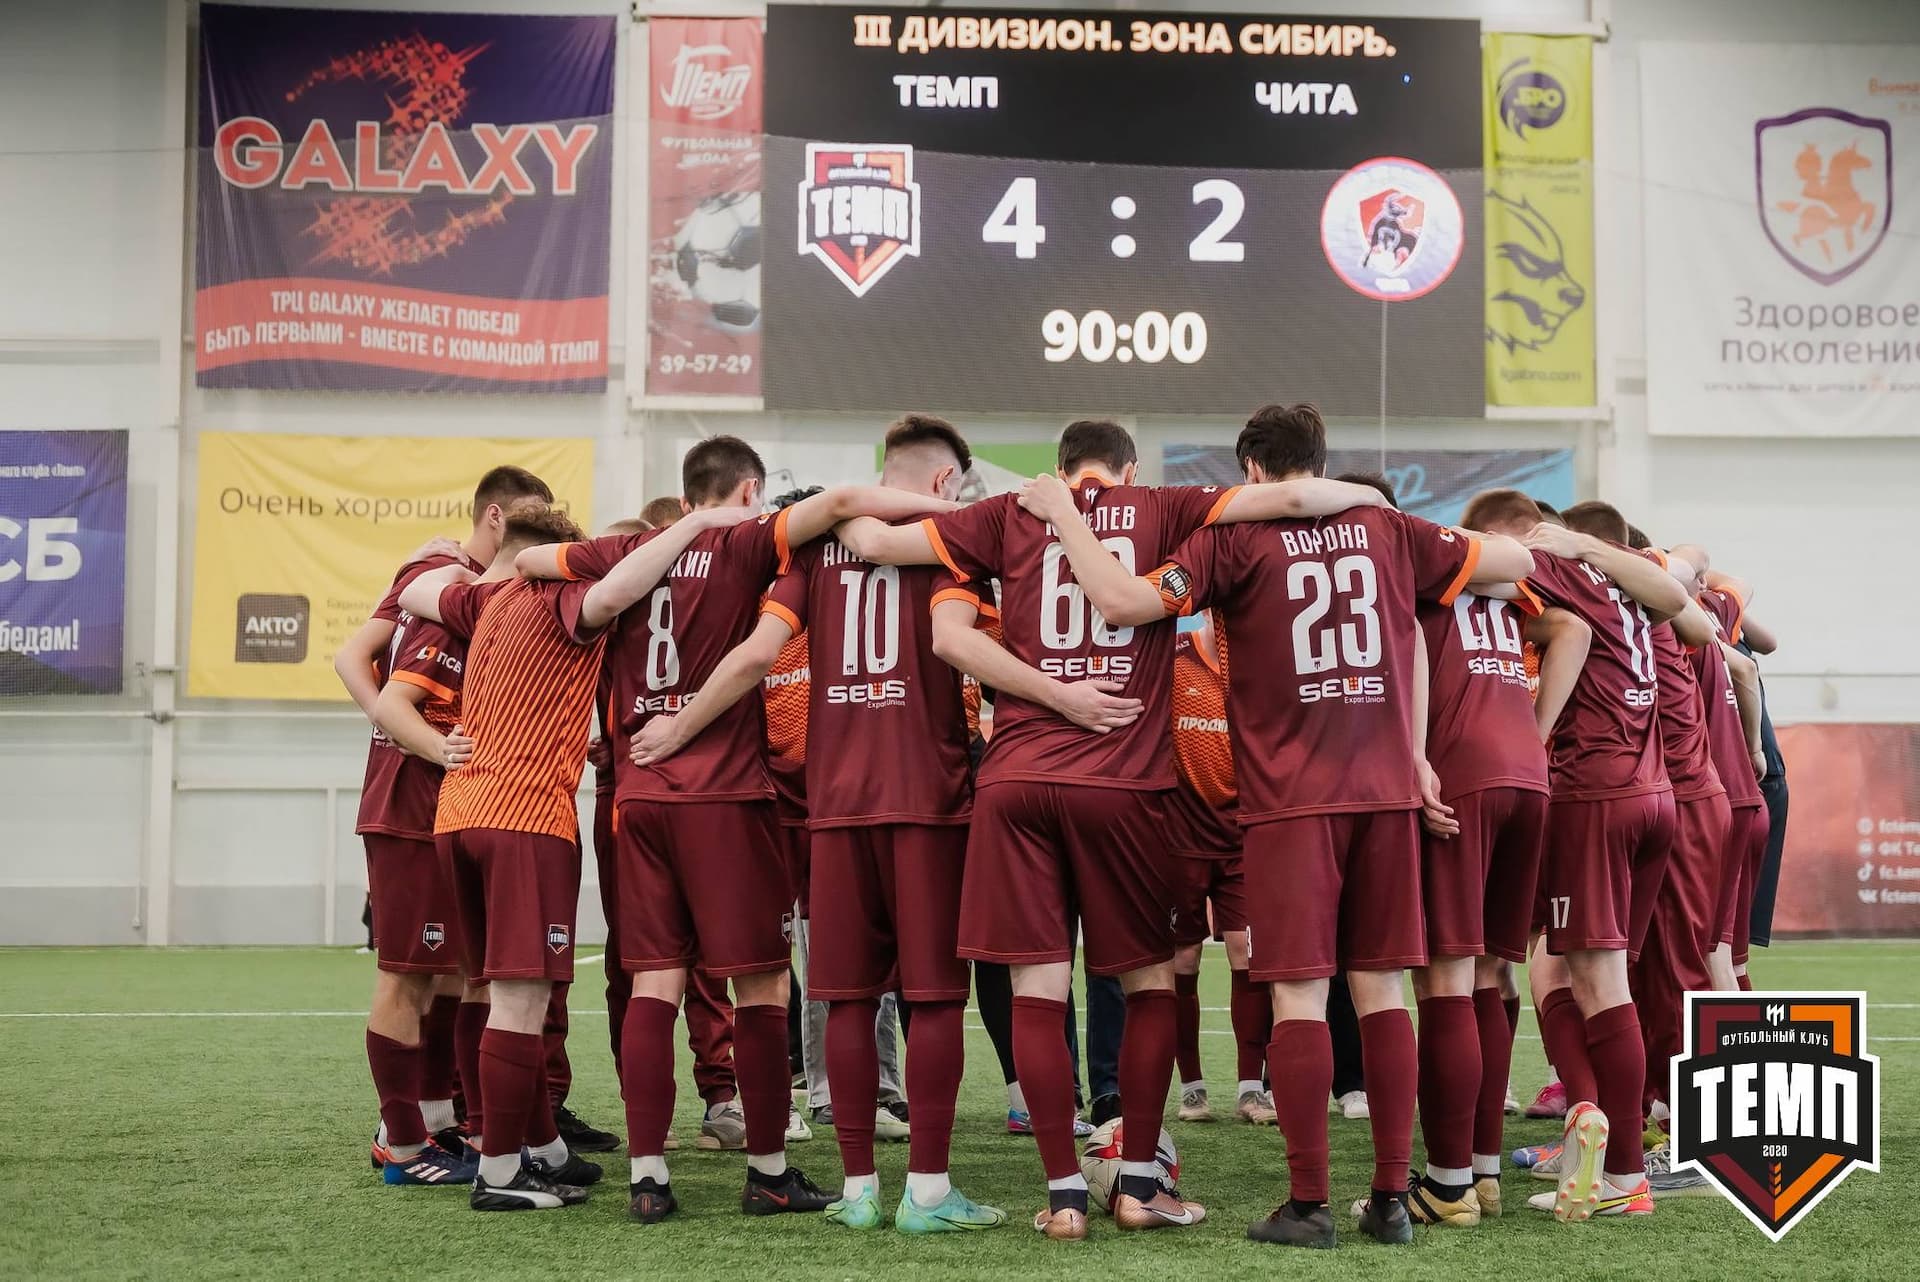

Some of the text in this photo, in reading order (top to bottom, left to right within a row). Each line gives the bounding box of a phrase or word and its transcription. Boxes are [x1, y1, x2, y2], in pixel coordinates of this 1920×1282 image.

[898, 16, 1122, 54] ДИВИЗИОН.
[1130, 21, 1233, 54] ЗОНА
[1239, 24, 1396, 57] СИБИРЬ.
[893, 75, 999, 108] ТЕМП
[1255, 82, 1358, 115] ЧИТА
[214, 116, 598, 196] GALAXY
[811, 186, 909, 240] ТЕМП
[982, 177, 1046, 259] 4
[1189, 179, 1246, 262] 2
[271, 290, 520, 336] ТРЦ GALAXY ЖЕЛАЕТ ПОБЕД!
[1734, 296, 1920, 331] Здоровое
[205, 325, 251, 353] БЫТЬ
[255, 321, 344, 345] ПЕРВЫМИ
[360, 325, 429, 356] ВМЕСТЕ
[433, 335, 445, 358] С
[449, 337, 546, 366] КОМАНДОЙ
[1041, 309, 1208, 365] 90:00
[660, 354, 752, 374] 39-57-29
[219, 487, 475, 523] Очень хороши
[1280, 523, 1369, 557] ВОРОНА
[667, 550, 713, 579] КИН
[245, 616, 298, 635] АКТО
[840, 564, 900, 676] 10
[1286, 555, 1382, 675] 23
[646, 586, 680, 691] 8
[436, 651, 462, 674] ПСБ
[1040, 656, 1133, 677] SEUS
[1468, 657, 1528, 682] SEUS
[827, 680, 906, 703] SEUS
[867, 701, 887, 709] Expor
[1299, 676, 1385, 703] SEUS
[1624, 688, 1655, 706] SE
[1551, 896, 1570, 928] 17
